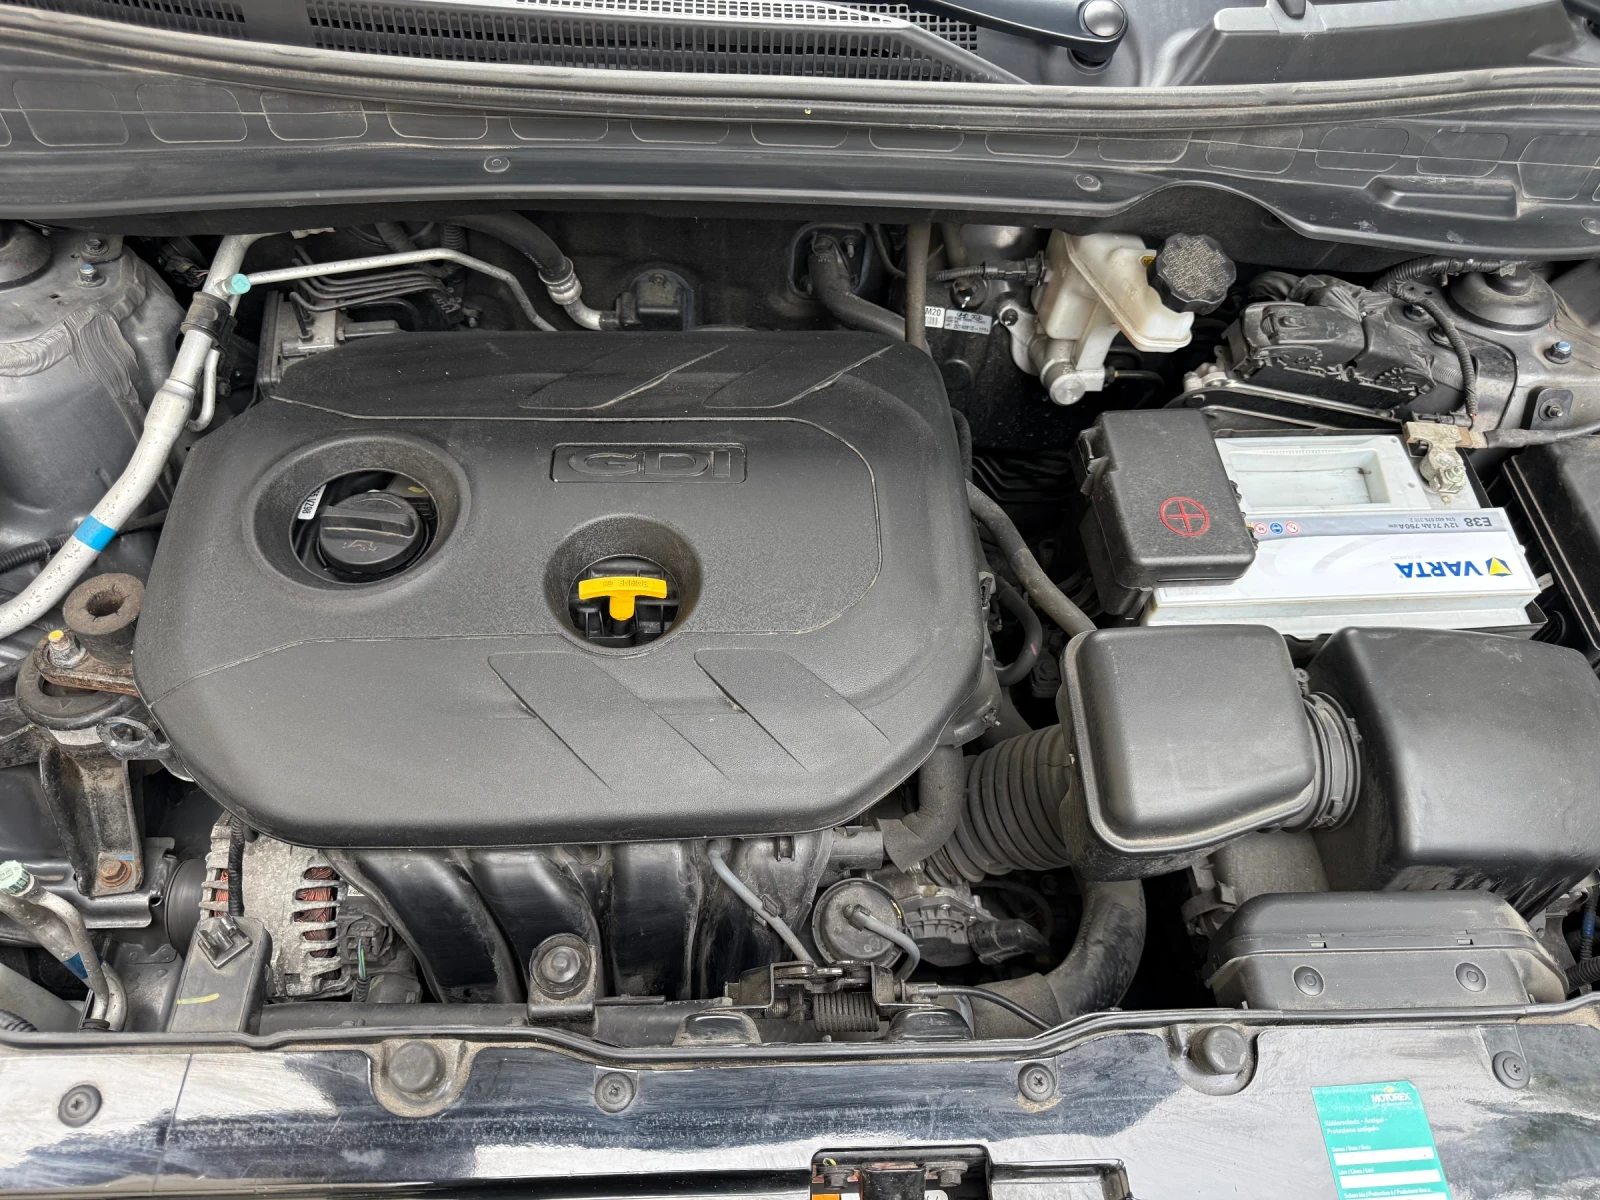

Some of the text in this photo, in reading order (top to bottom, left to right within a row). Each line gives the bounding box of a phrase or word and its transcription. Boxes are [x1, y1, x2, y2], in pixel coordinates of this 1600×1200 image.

[568, 450, 731, 478] GDI
[1463, 516, 1492, 527] E38
[1393, 561, 1484, 579] VARTA
[1371, 1093, 1412, 1102] MOTOREX
